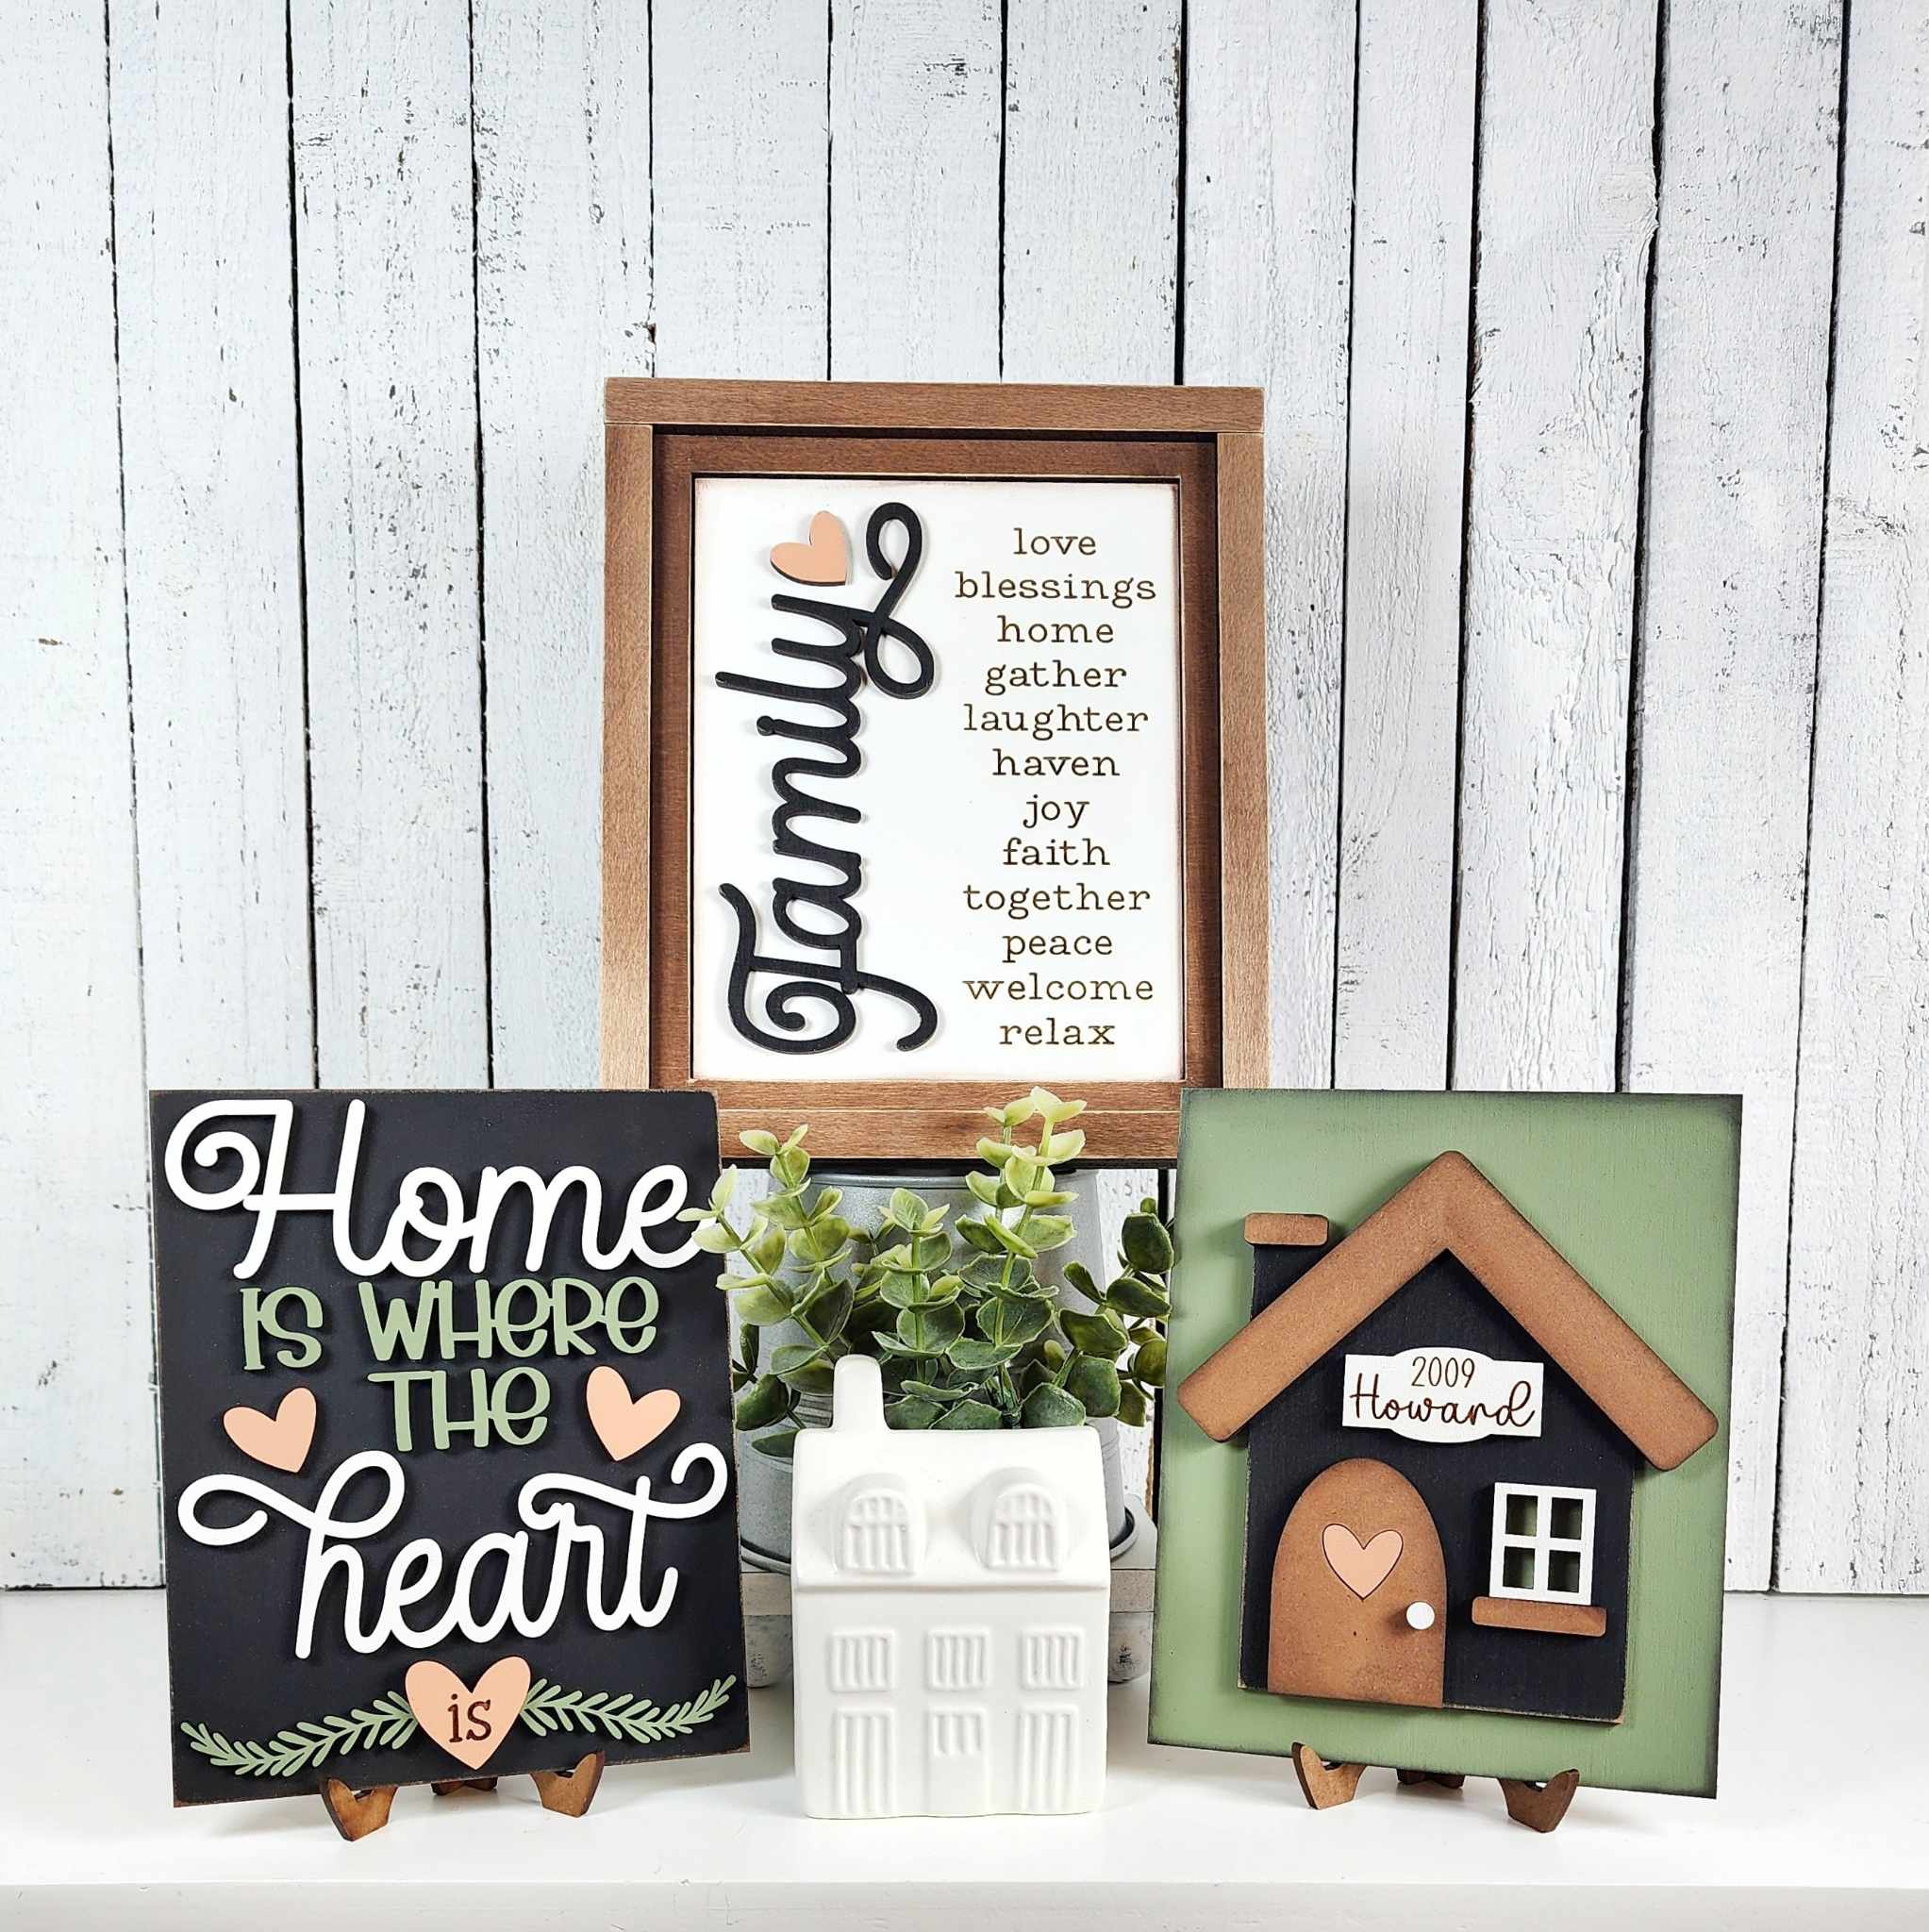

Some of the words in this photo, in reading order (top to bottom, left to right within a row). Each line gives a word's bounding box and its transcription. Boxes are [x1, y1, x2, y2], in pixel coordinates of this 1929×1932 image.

[1014, 528, 1096, 555] love
[955, 571, 1156, 608] blessings
[997, 615, 1113, 643] home
[985, 659, 1126, 695] gather
[964, 705, 1148, 741] laughter
[715, 501, 940, 1056] Family
[992, 748, 1120, 776] haven
[1023, 794, 1089, 828] joy
[1004, 838, 1110, 865] faith
[963, 883, 1150, 920] together
[1003, 936, 1112, 963] peace
[963, 973, 1153, 1000] welcome
[1000, 1018, 1115, 1045] relax
[164, 1099, 719, 1280] Home
[241, 1286, 324, 1372] IS
[1411, 1356, 1475, 1388] 2009
[1350, 1373, 1536, 1427] Howard
[177, 1442, 729, 1660] heart
[448, 1693, 492, 1744] is
